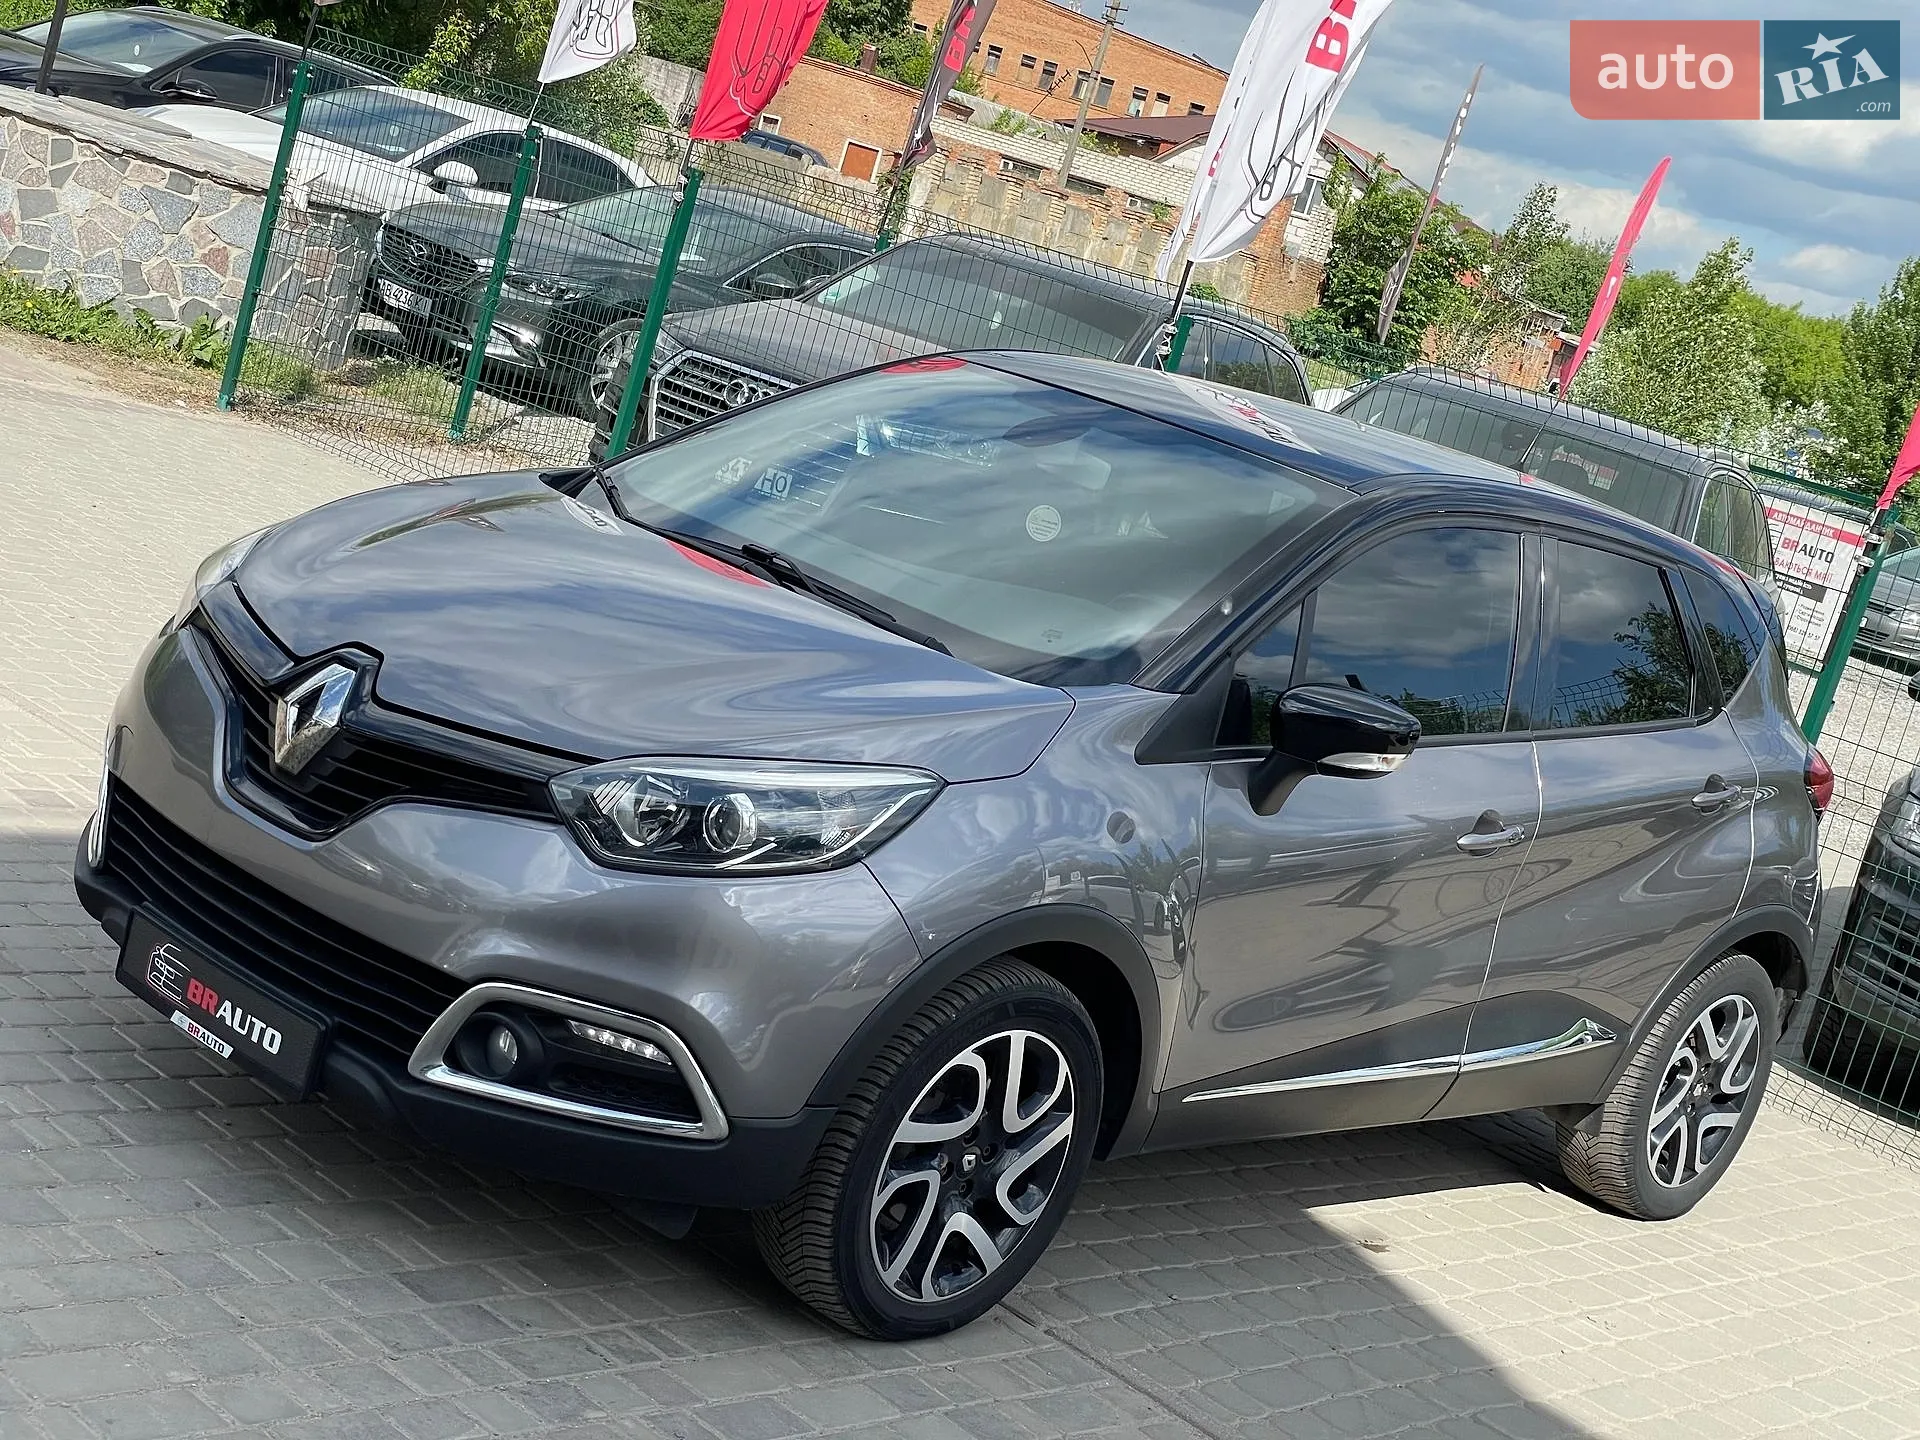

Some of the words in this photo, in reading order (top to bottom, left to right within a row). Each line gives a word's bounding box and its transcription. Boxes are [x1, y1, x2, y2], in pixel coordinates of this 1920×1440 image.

[1780, 537, 1835, 564] BRAUTO
[187, 977, 282, 1055] BRAUTO
[187, 1022, 225, 1054] BRAUTO
